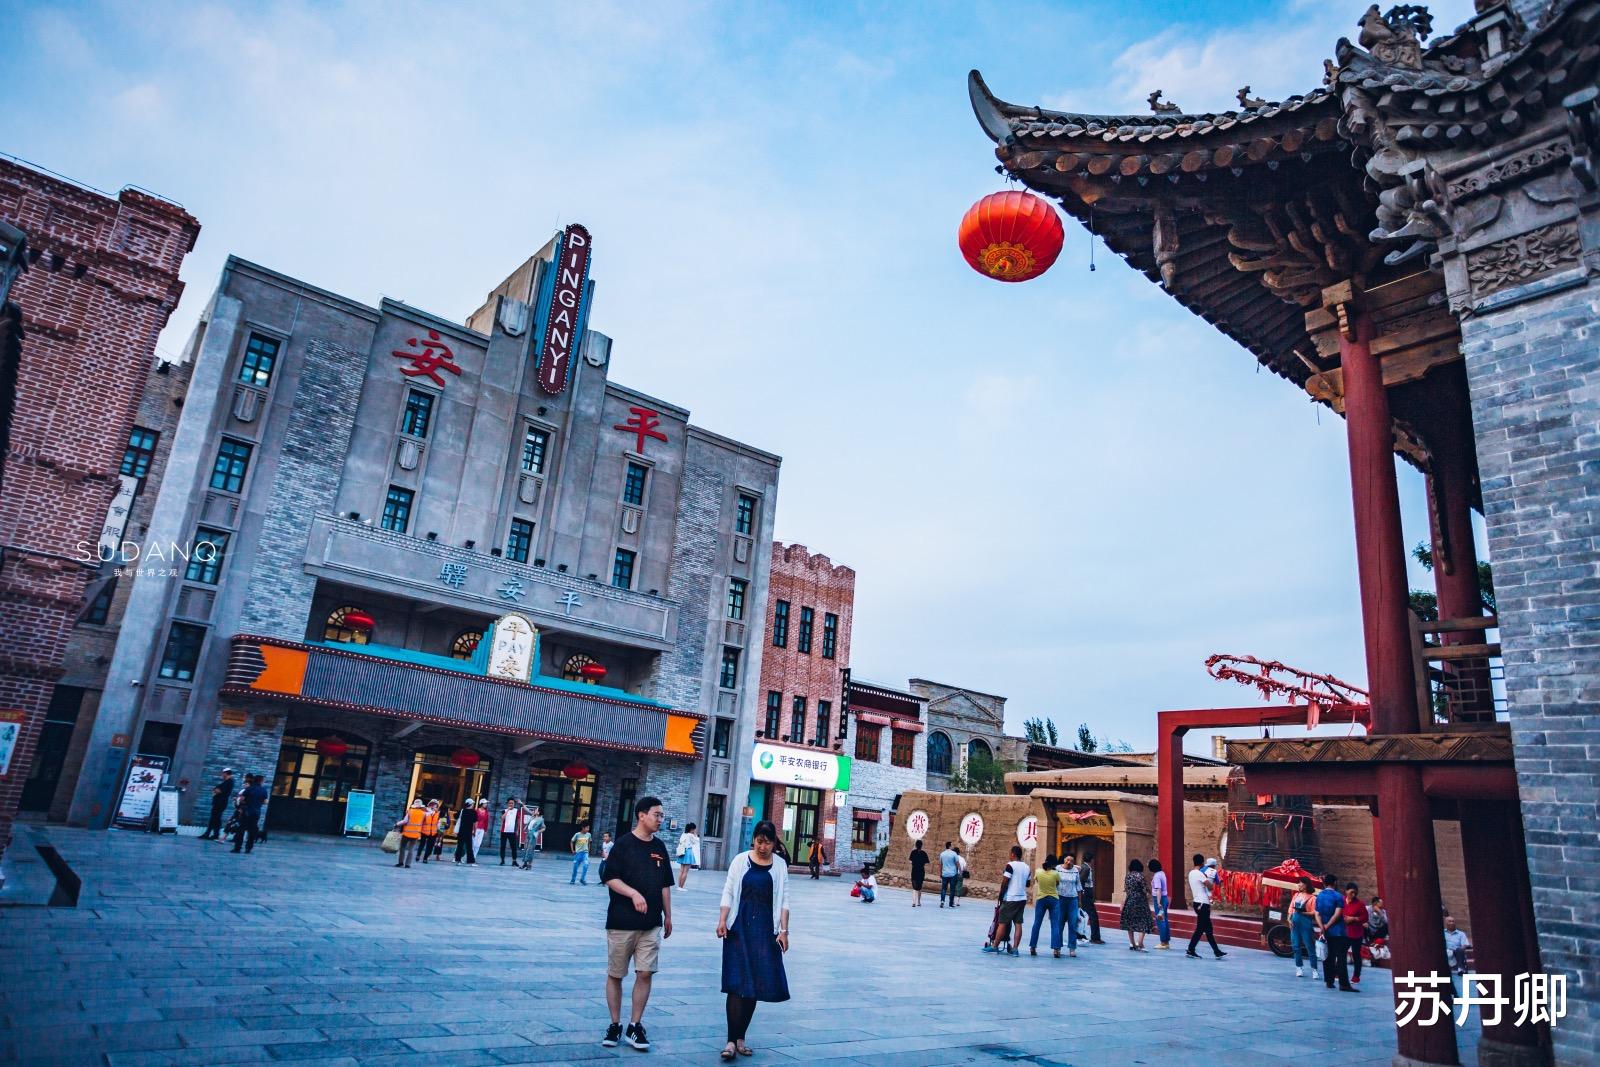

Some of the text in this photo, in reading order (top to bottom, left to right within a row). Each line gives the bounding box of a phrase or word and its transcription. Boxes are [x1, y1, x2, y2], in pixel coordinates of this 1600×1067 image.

[549, 232, 585, 384] PINGANYI
[391, 329, 462, 388] 安
[613, 407, 669, 455] 平
[101, 486, 132, 551] 社會服
[780, 756, 828, 771] 平安农商银行
